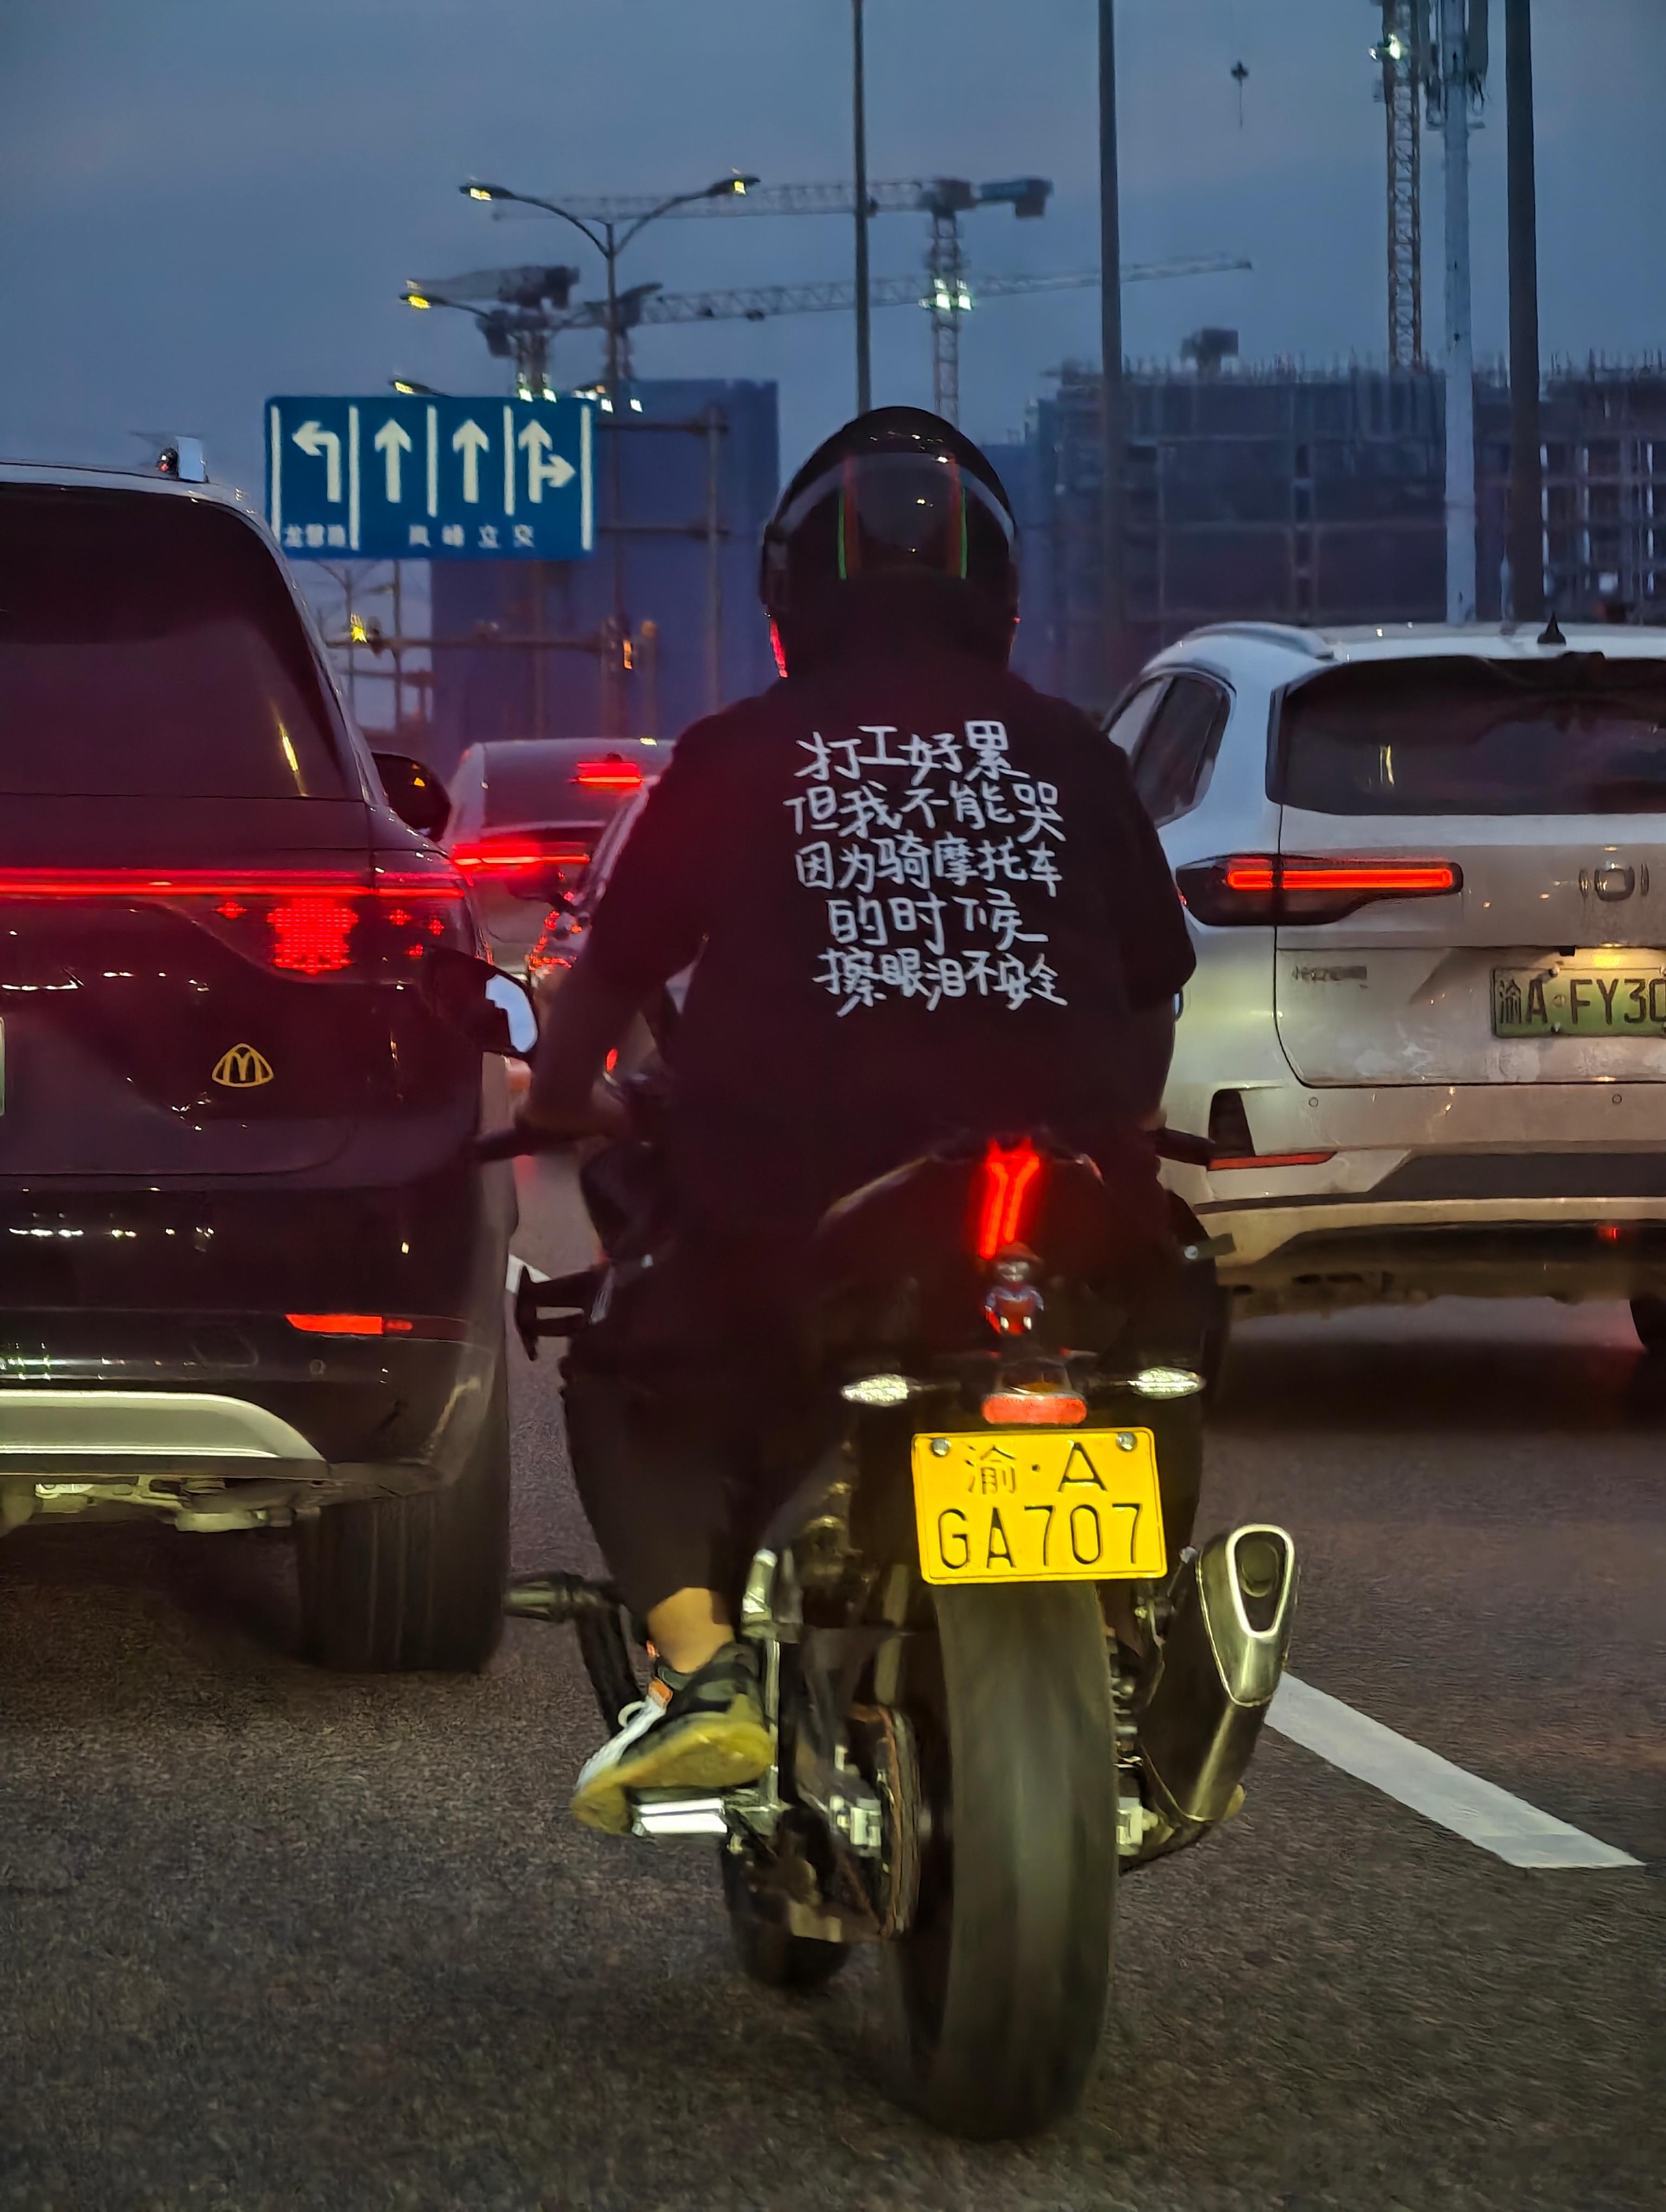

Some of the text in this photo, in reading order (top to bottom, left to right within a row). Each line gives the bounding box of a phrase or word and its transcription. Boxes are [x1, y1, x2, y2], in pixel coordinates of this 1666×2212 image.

[794, 720, 1030, 786] 打工好累
[783, 780, 1067, 842] 但我不能哭
[794, 830, 1063, 897] 因为骑摩托车
[825, 888, 1049, 956] 的时候
[812, 946, 1068, 1018] 擦眼泪不安全
[938, 1502, 1143, 1570] GA707
